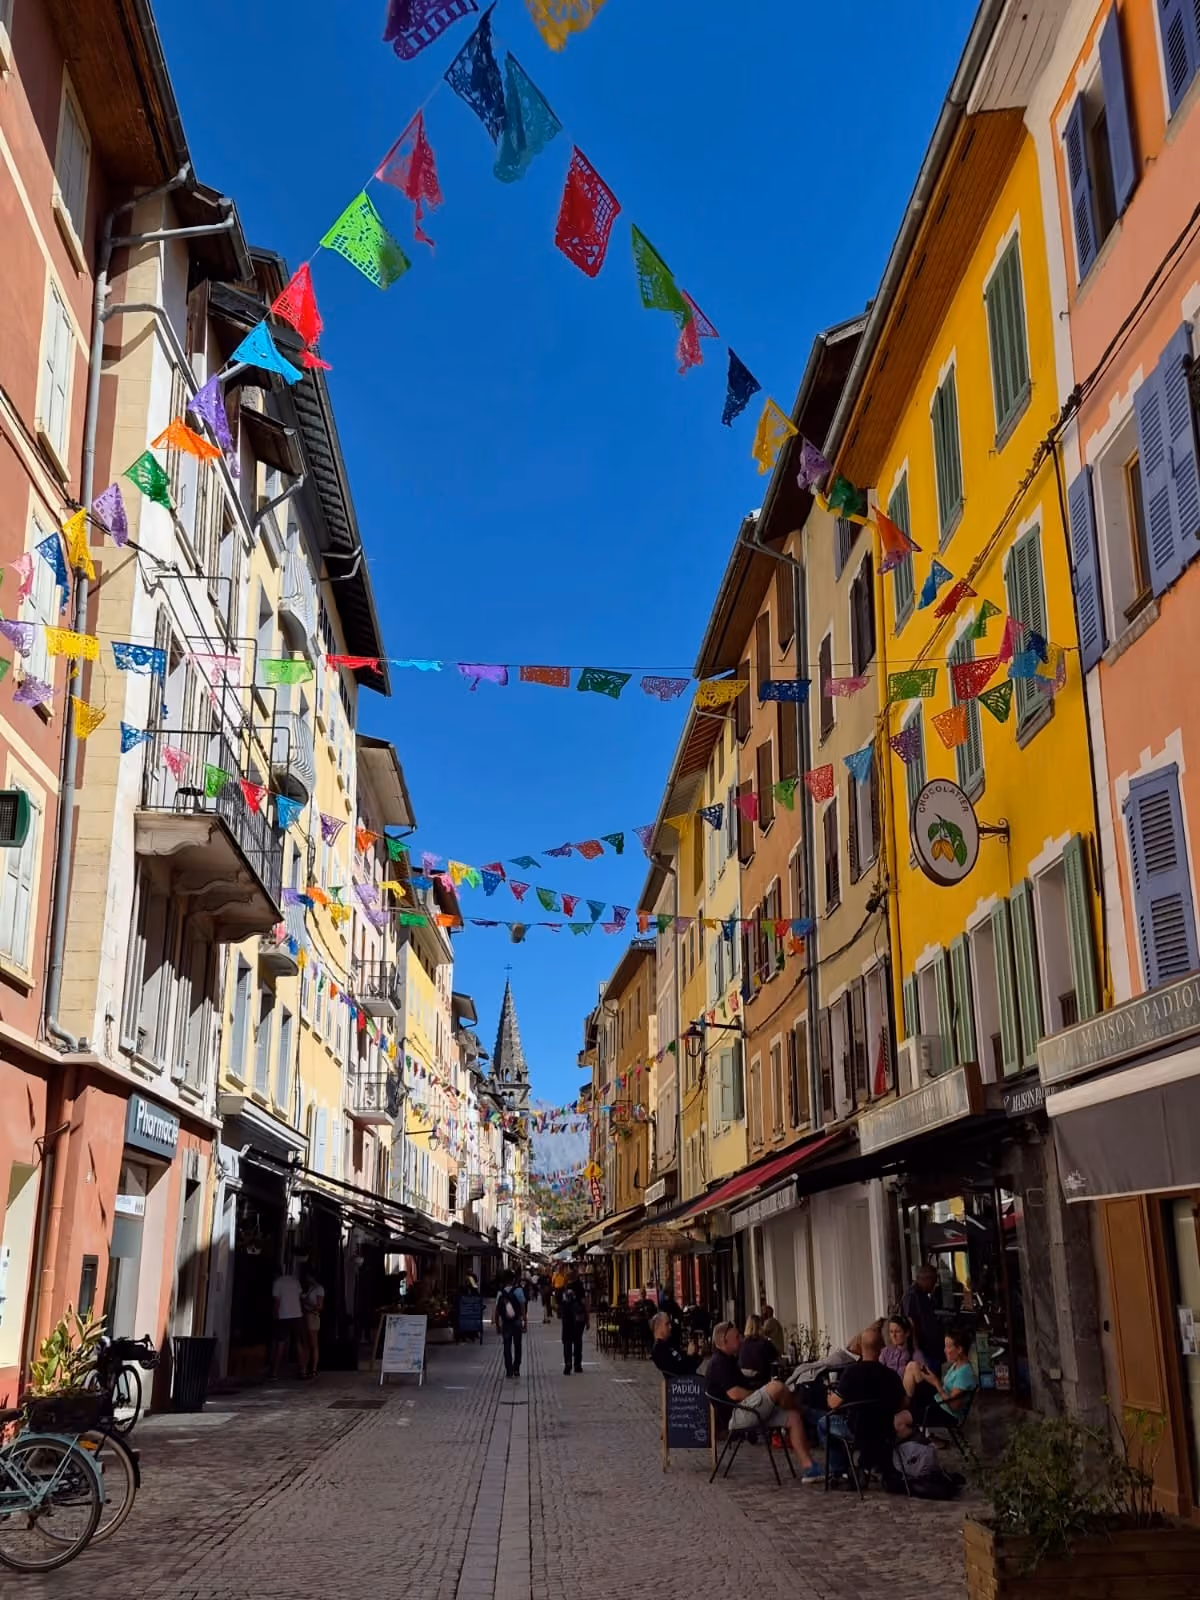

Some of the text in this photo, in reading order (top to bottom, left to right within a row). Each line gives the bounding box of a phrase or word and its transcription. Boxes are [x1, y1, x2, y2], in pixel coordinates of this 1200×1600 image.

[919, 785, 969, 813] CHOCOLATIER
[1081, 1008, 1136, 1049] MAISON
[1011, 1089, 1034, 1112] MAISON
[135, 1099, 179, 1145] Pharmacie
[671, 1383, 700, 1395] PADIOU
